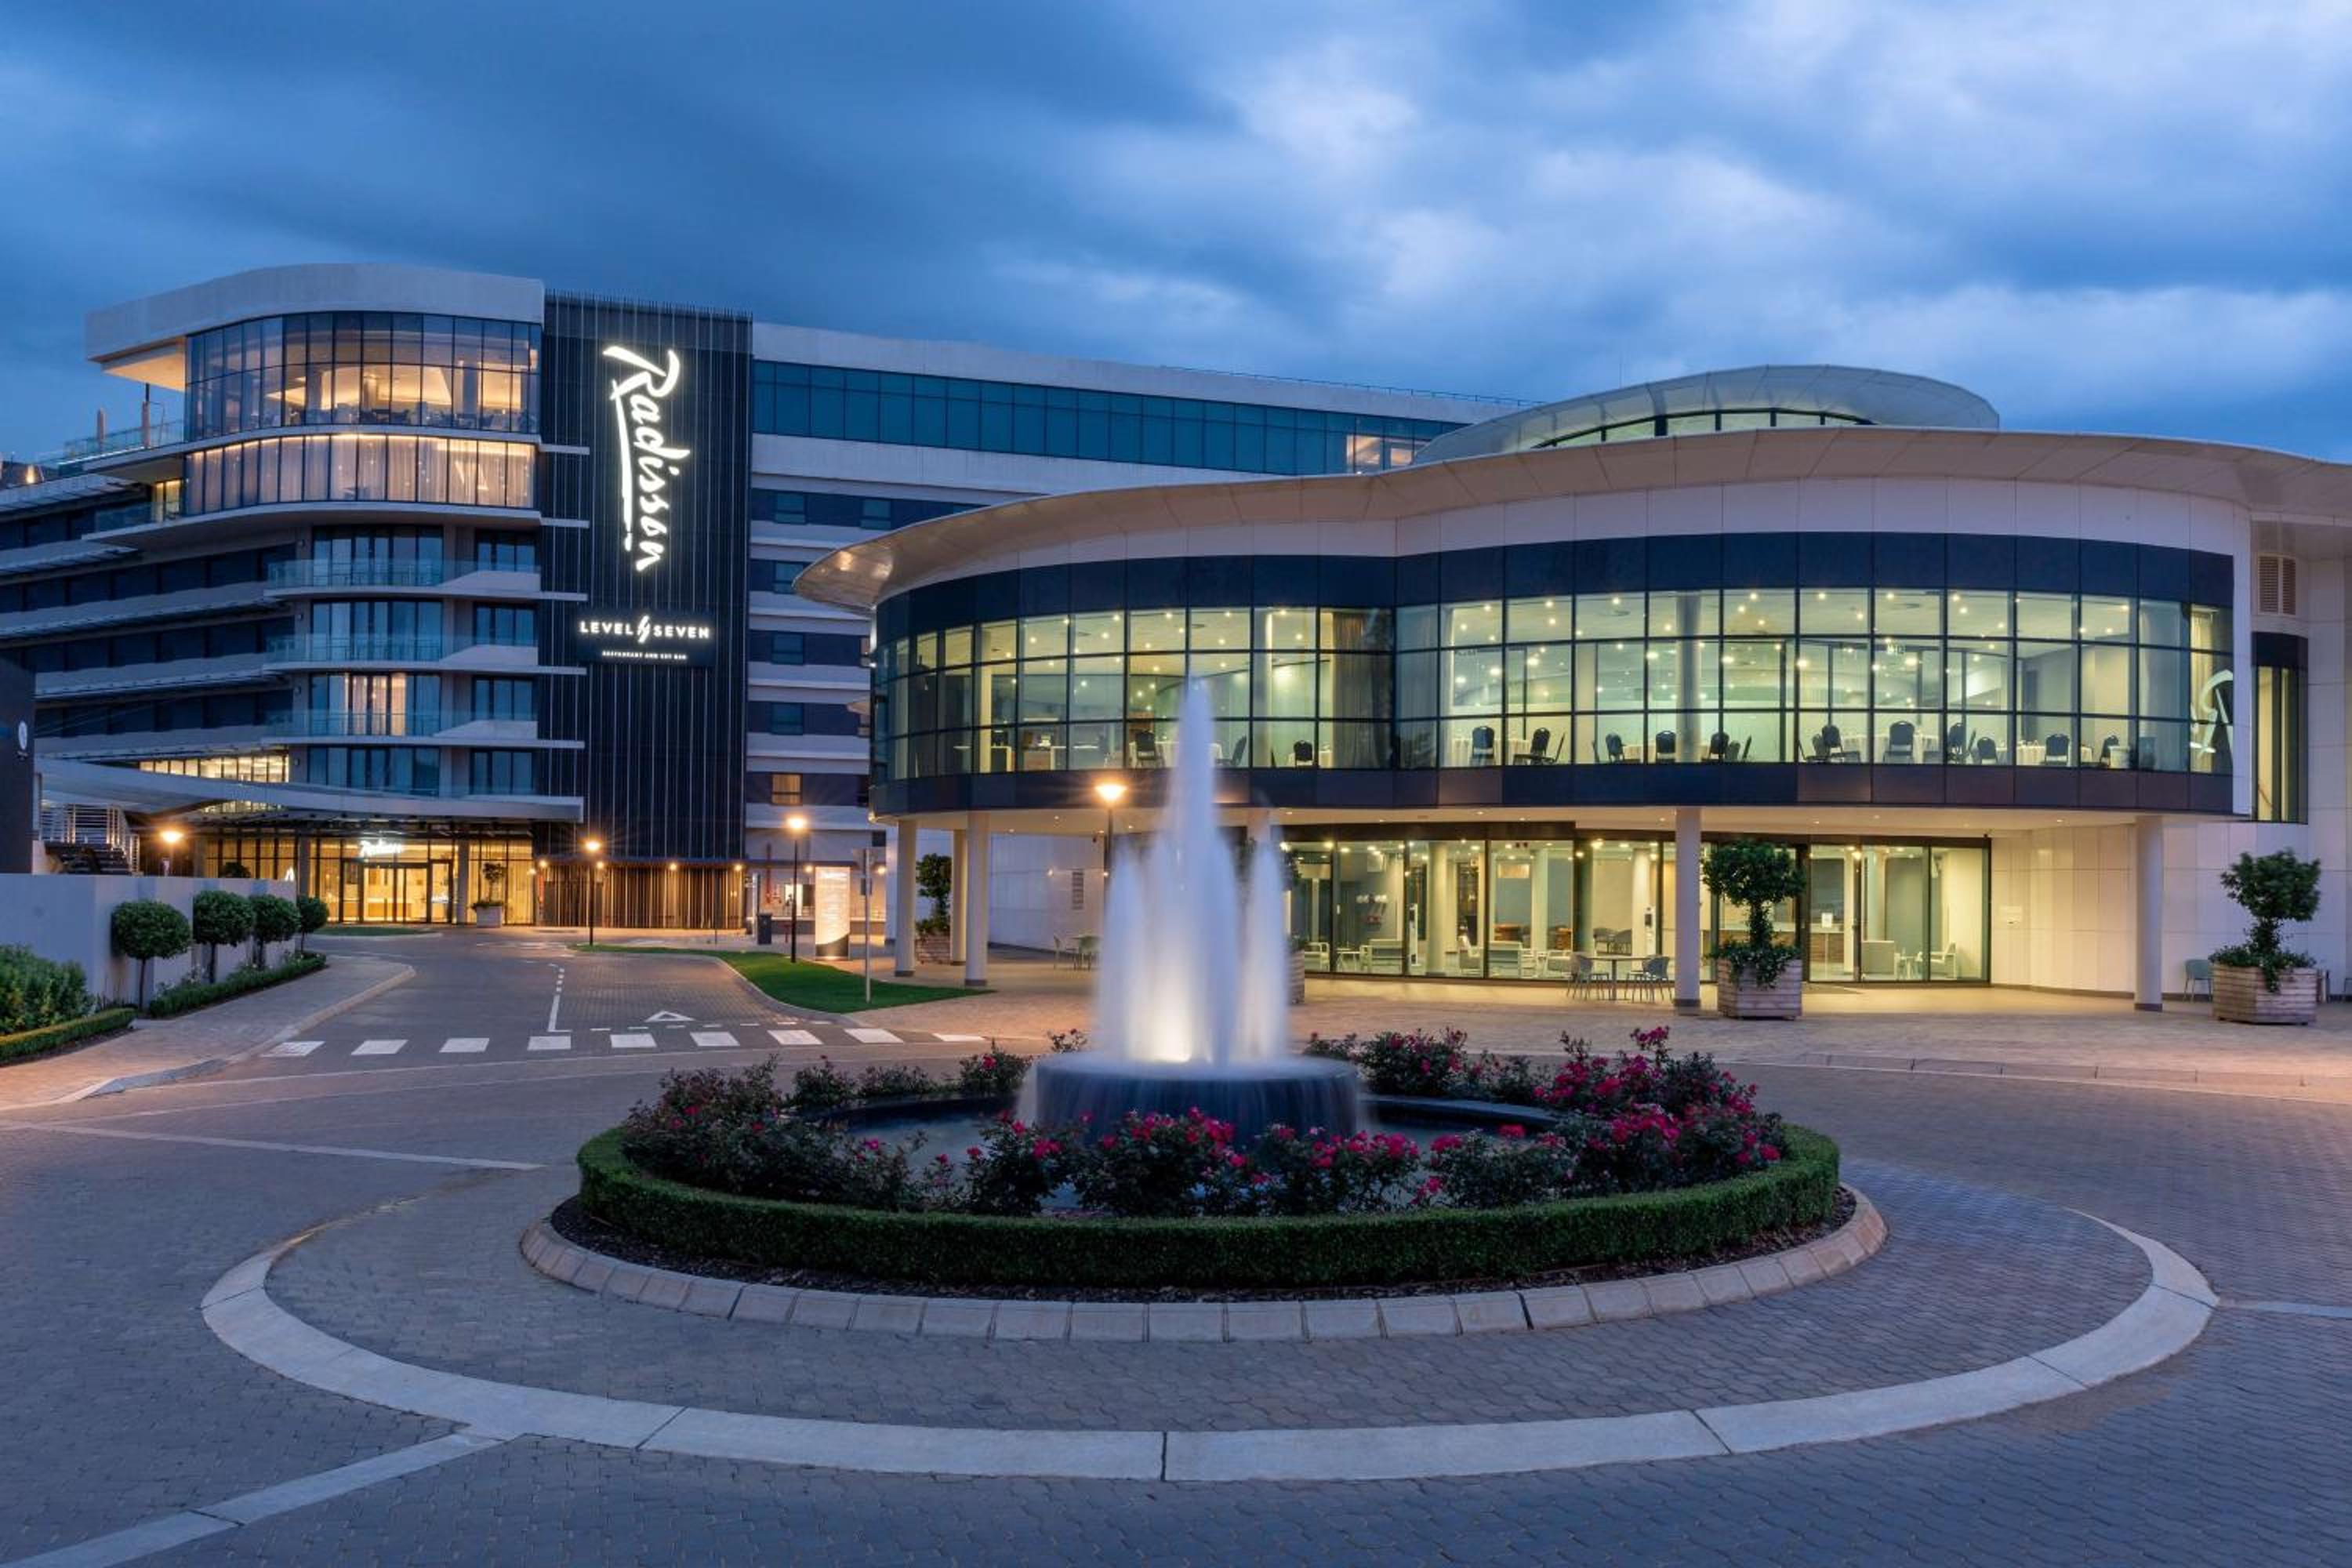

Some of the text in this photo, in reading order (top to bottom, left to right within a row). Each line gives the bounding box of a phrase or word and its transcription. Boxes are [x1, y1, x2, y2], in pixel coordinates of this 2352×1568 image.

[602, 345, 691, 572] Radisson
[579, 620, 710, 639] LEVEL SEVEN
